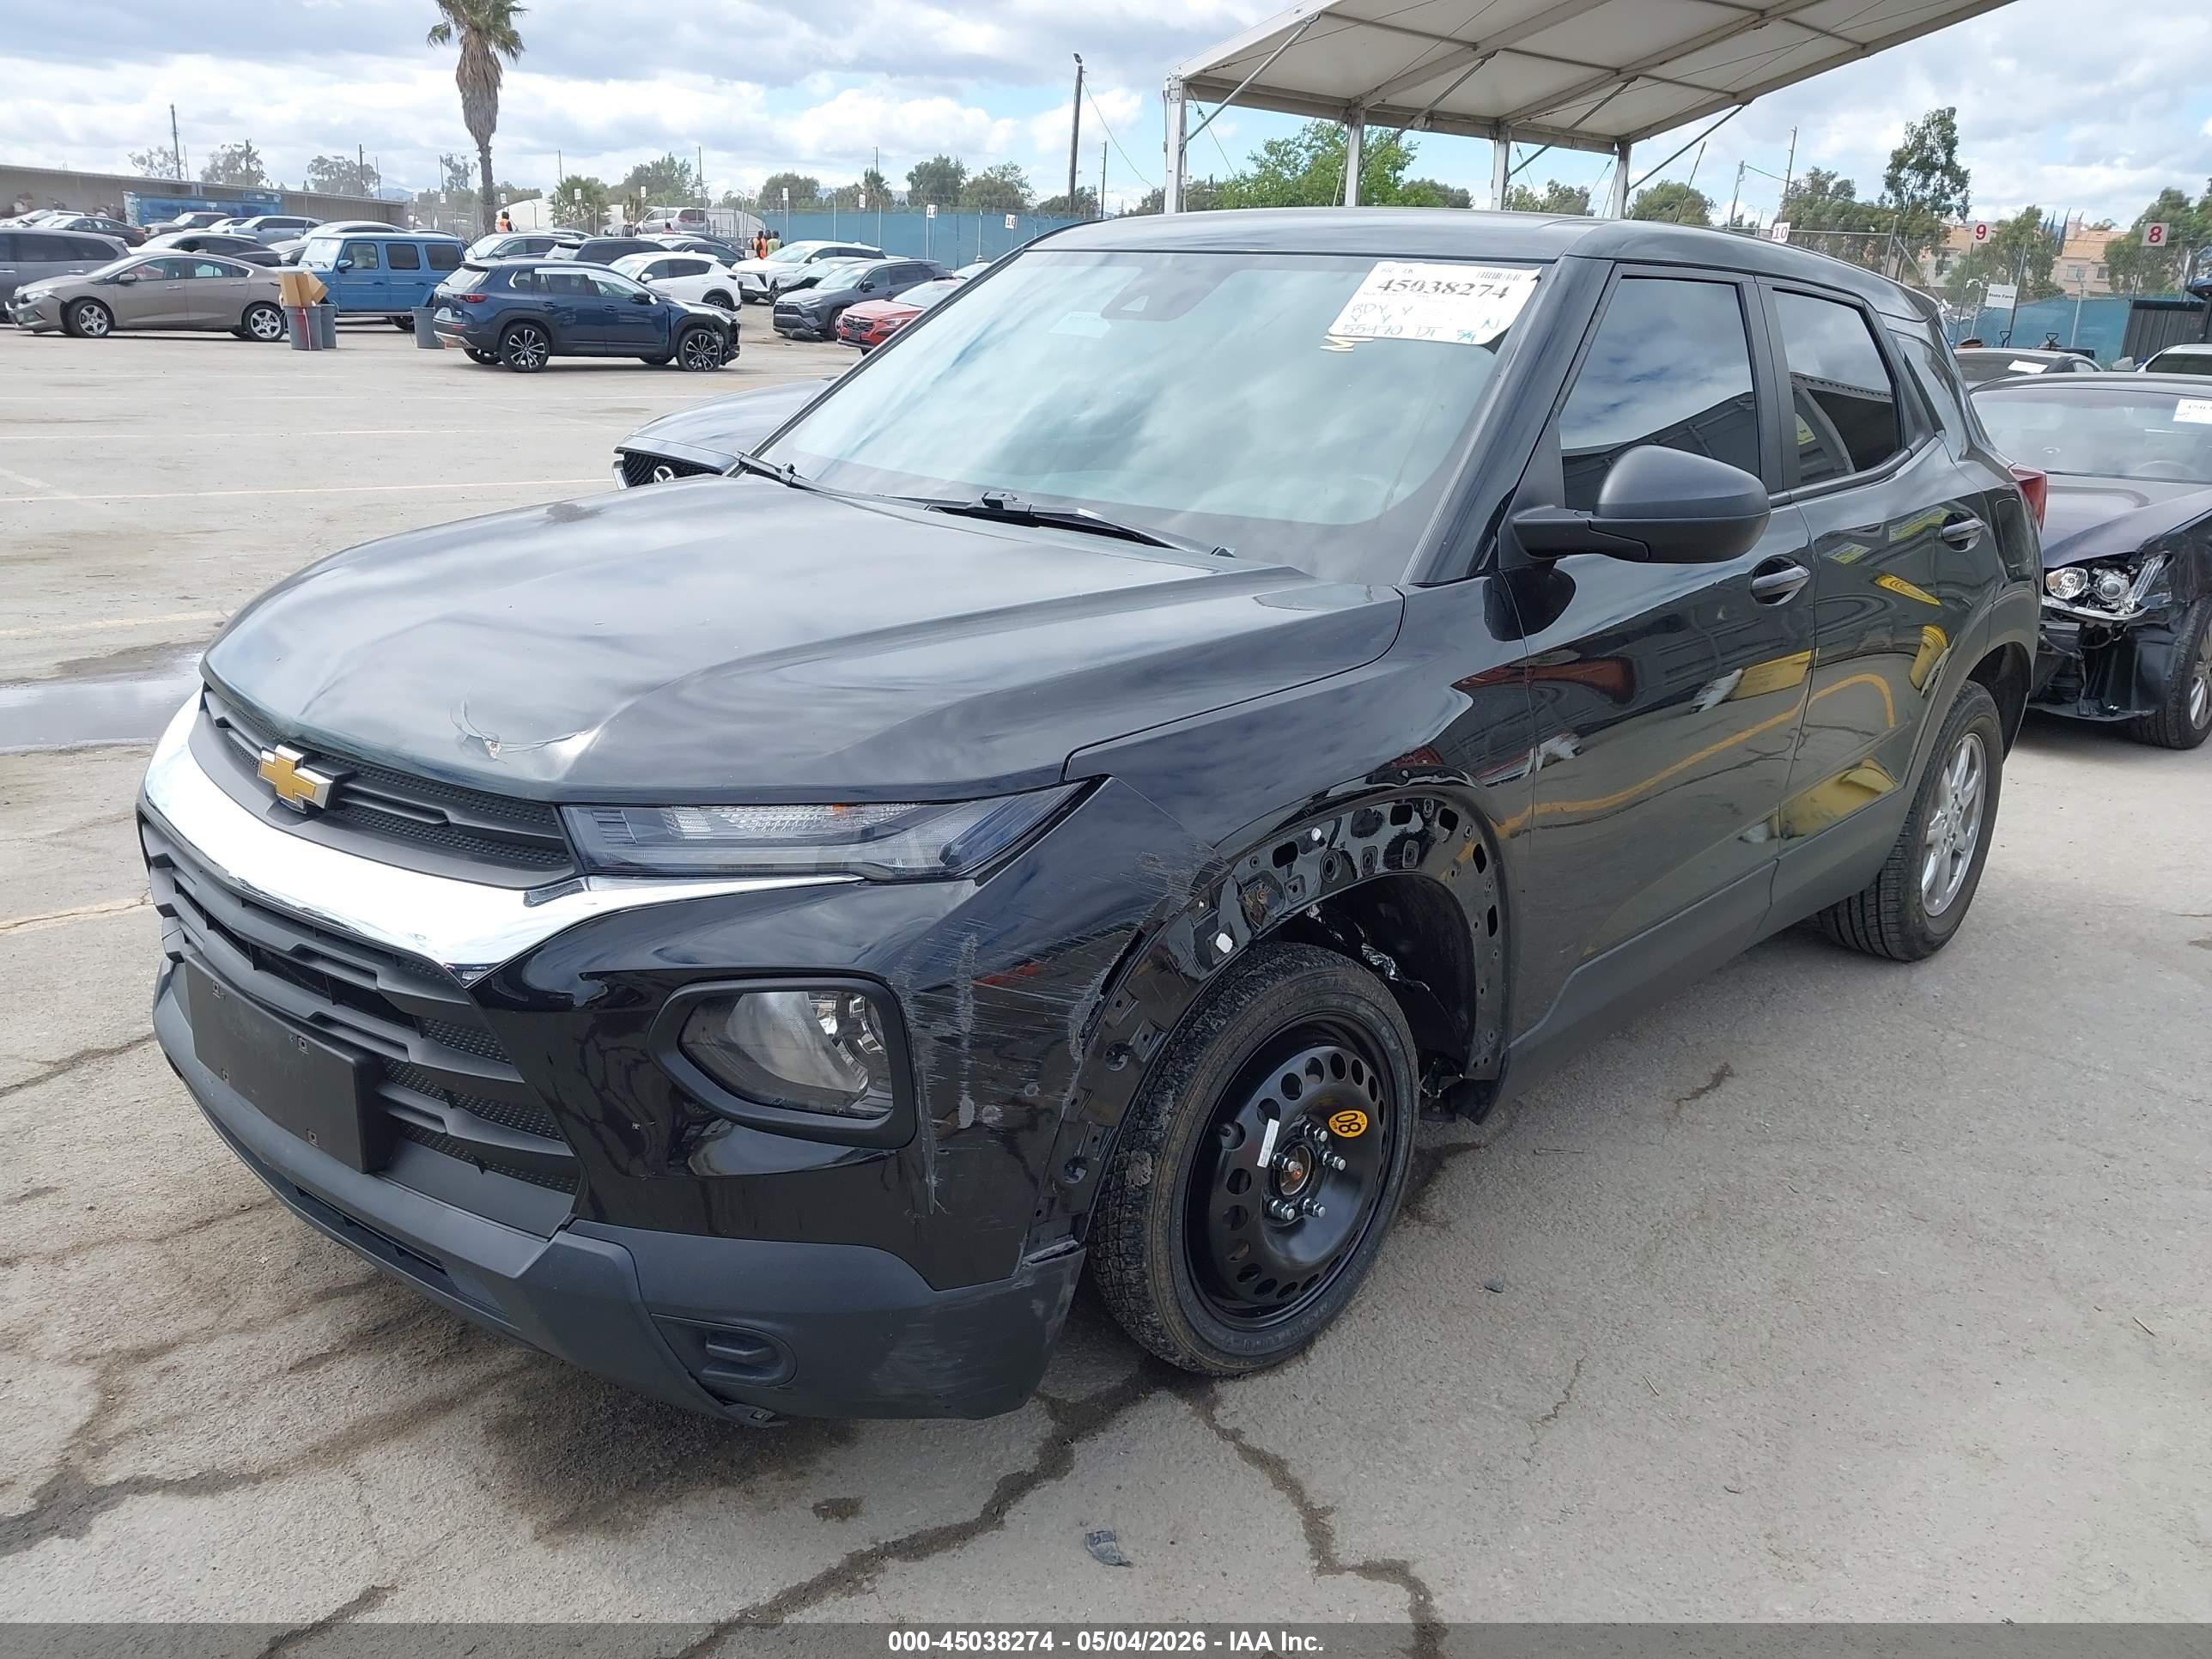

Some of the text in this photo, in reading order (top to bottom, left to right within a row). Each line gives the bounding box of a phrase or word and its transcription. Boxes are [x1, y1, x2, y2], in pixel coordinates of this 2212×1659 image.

[1007, 216, 1017, 228] 16
[1773, 226, 1788, 240] 10
[1975, 223, 1987, 240] 9
[2148, 225, 2162, 243] 8
[1377, 278, 1511, 299] 45038274
[1335, 1113, 1362, 1133] 80
